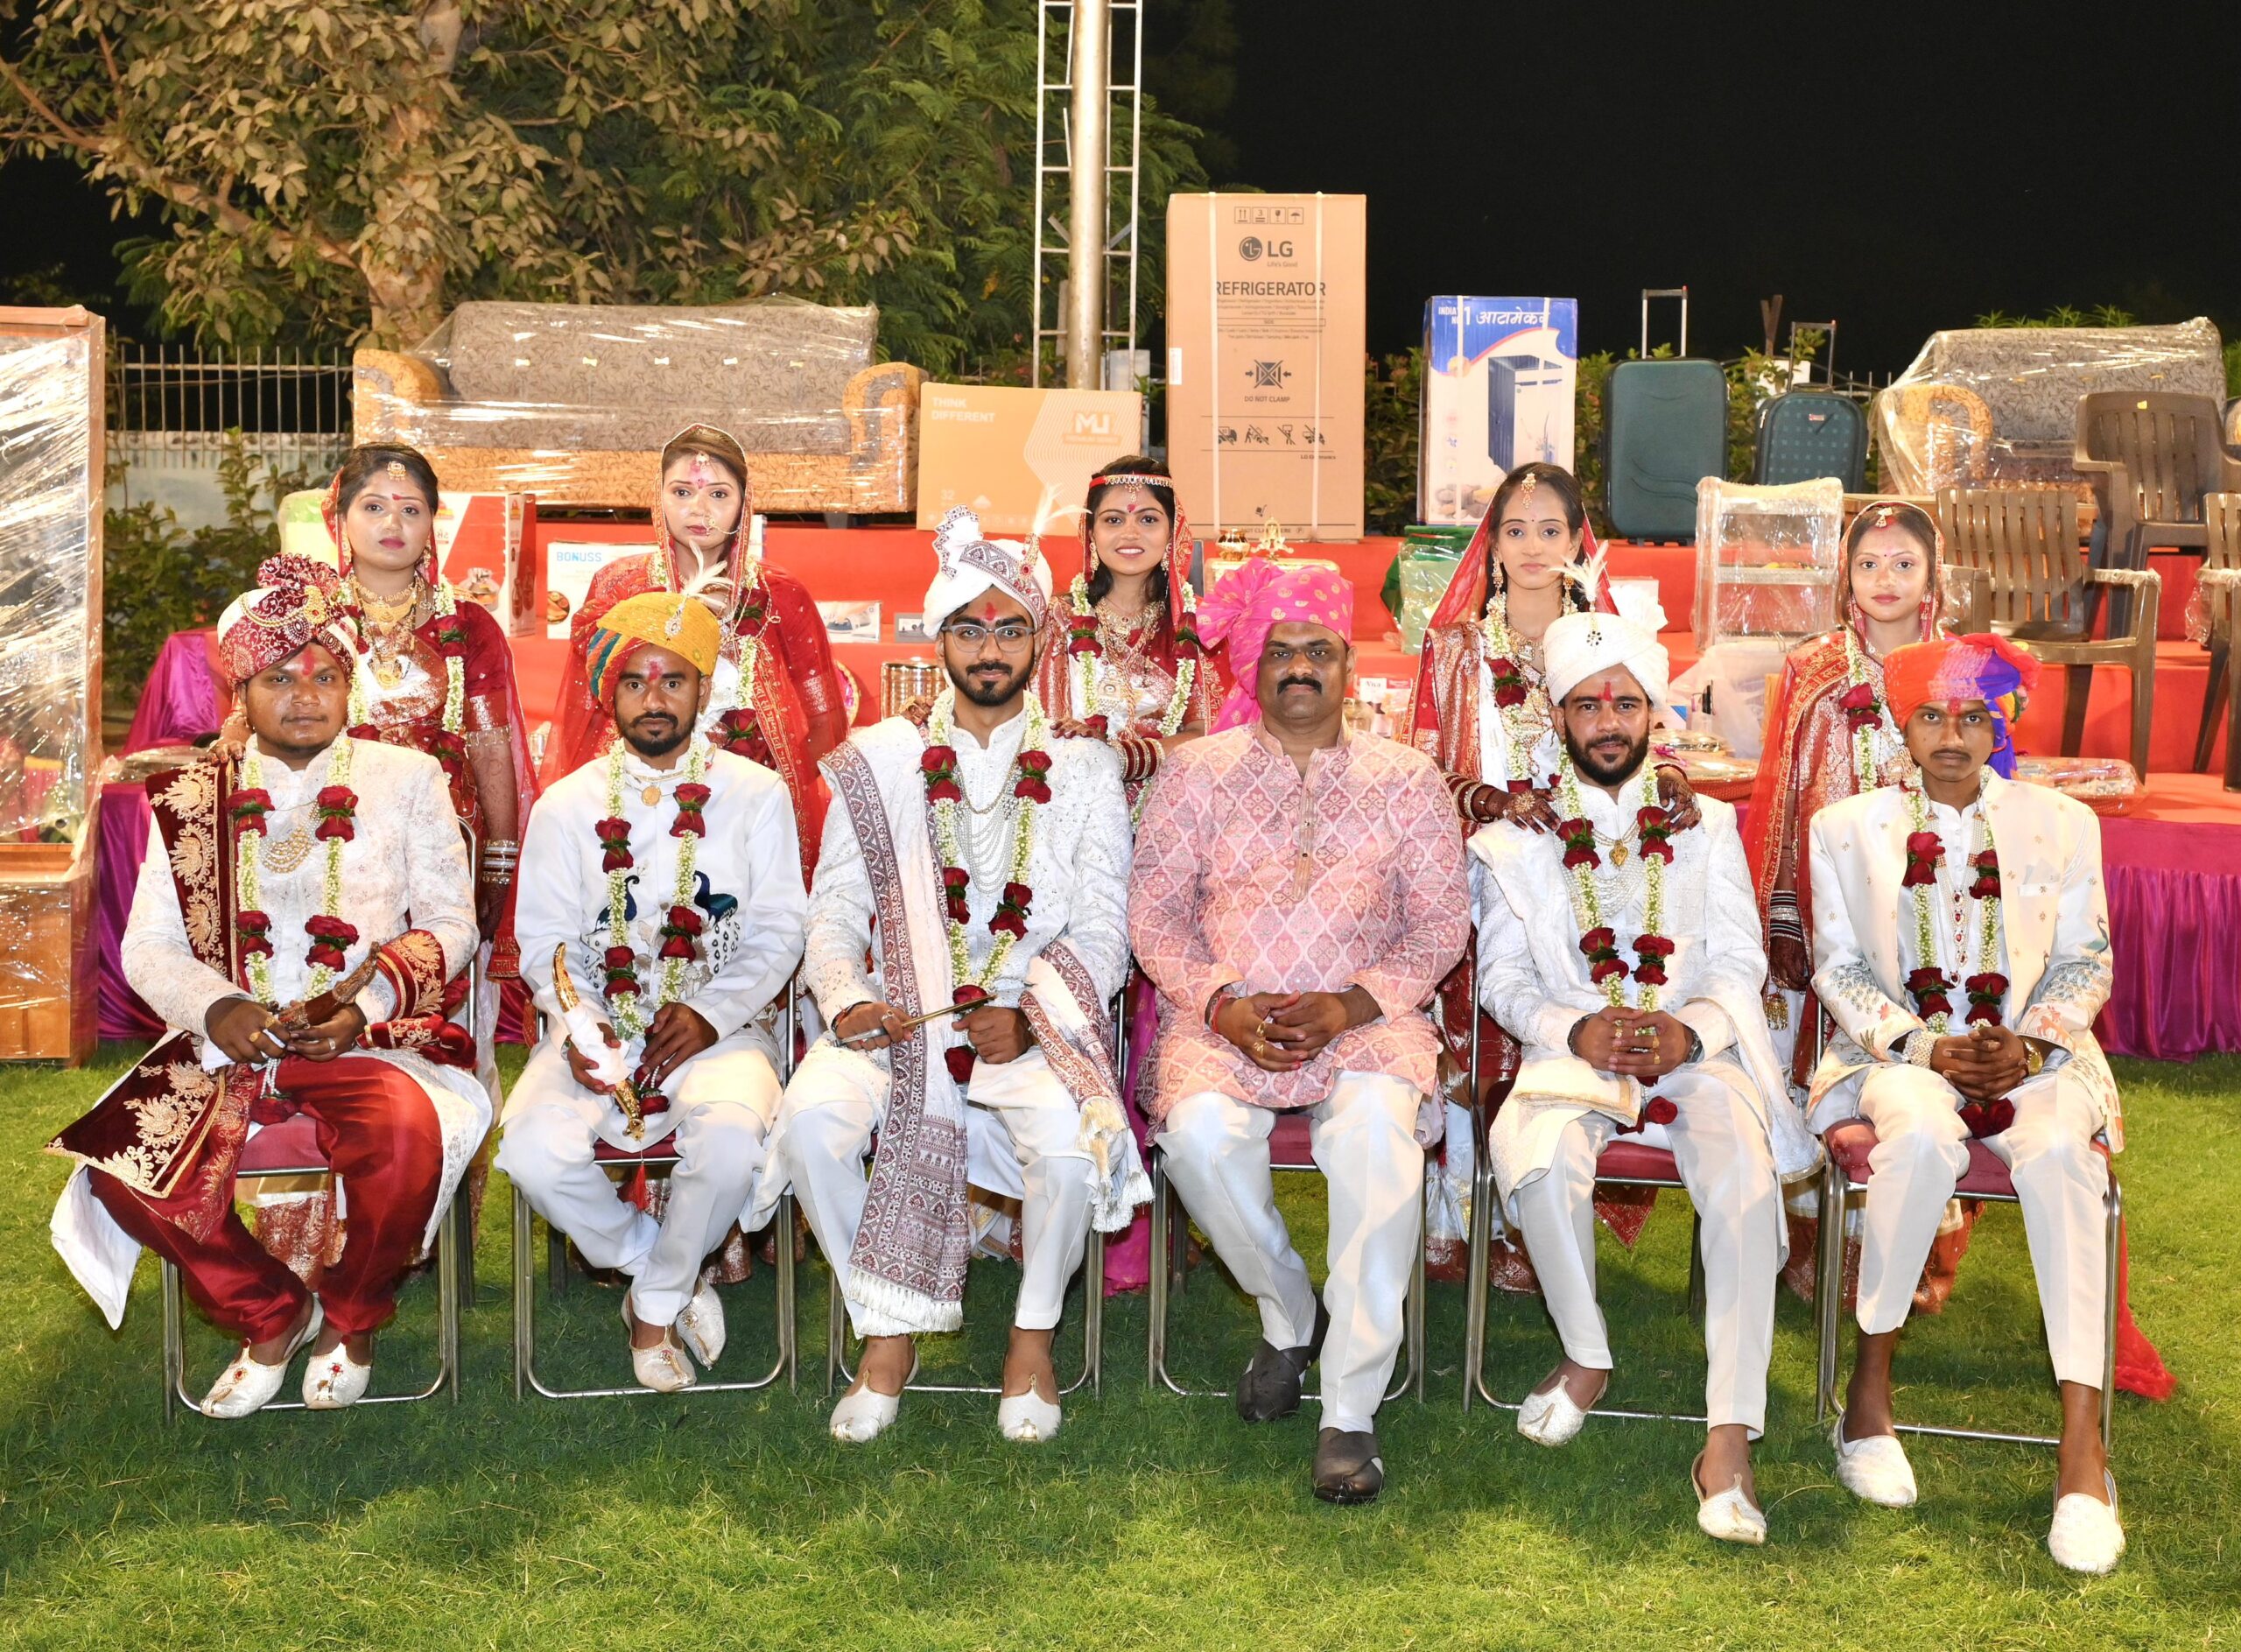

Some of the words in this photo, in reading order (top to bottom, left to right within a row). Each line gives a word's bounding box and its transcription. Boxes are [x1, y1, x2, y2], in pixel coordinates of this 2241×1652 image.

[1268, 241, 1293, 257] LG
[1217, 281, 1326, 296] REFRIGERATOR
[1438, 306, 1458, 315] INDIA
[1464, 306, 1472, 325] 1
[932, 398, 966, 408] THINK
[932, 411, 994, 422] DIFFERENT
[941, 490, 954, 500] 32
[556, 552, 602, 562] BONUSS
